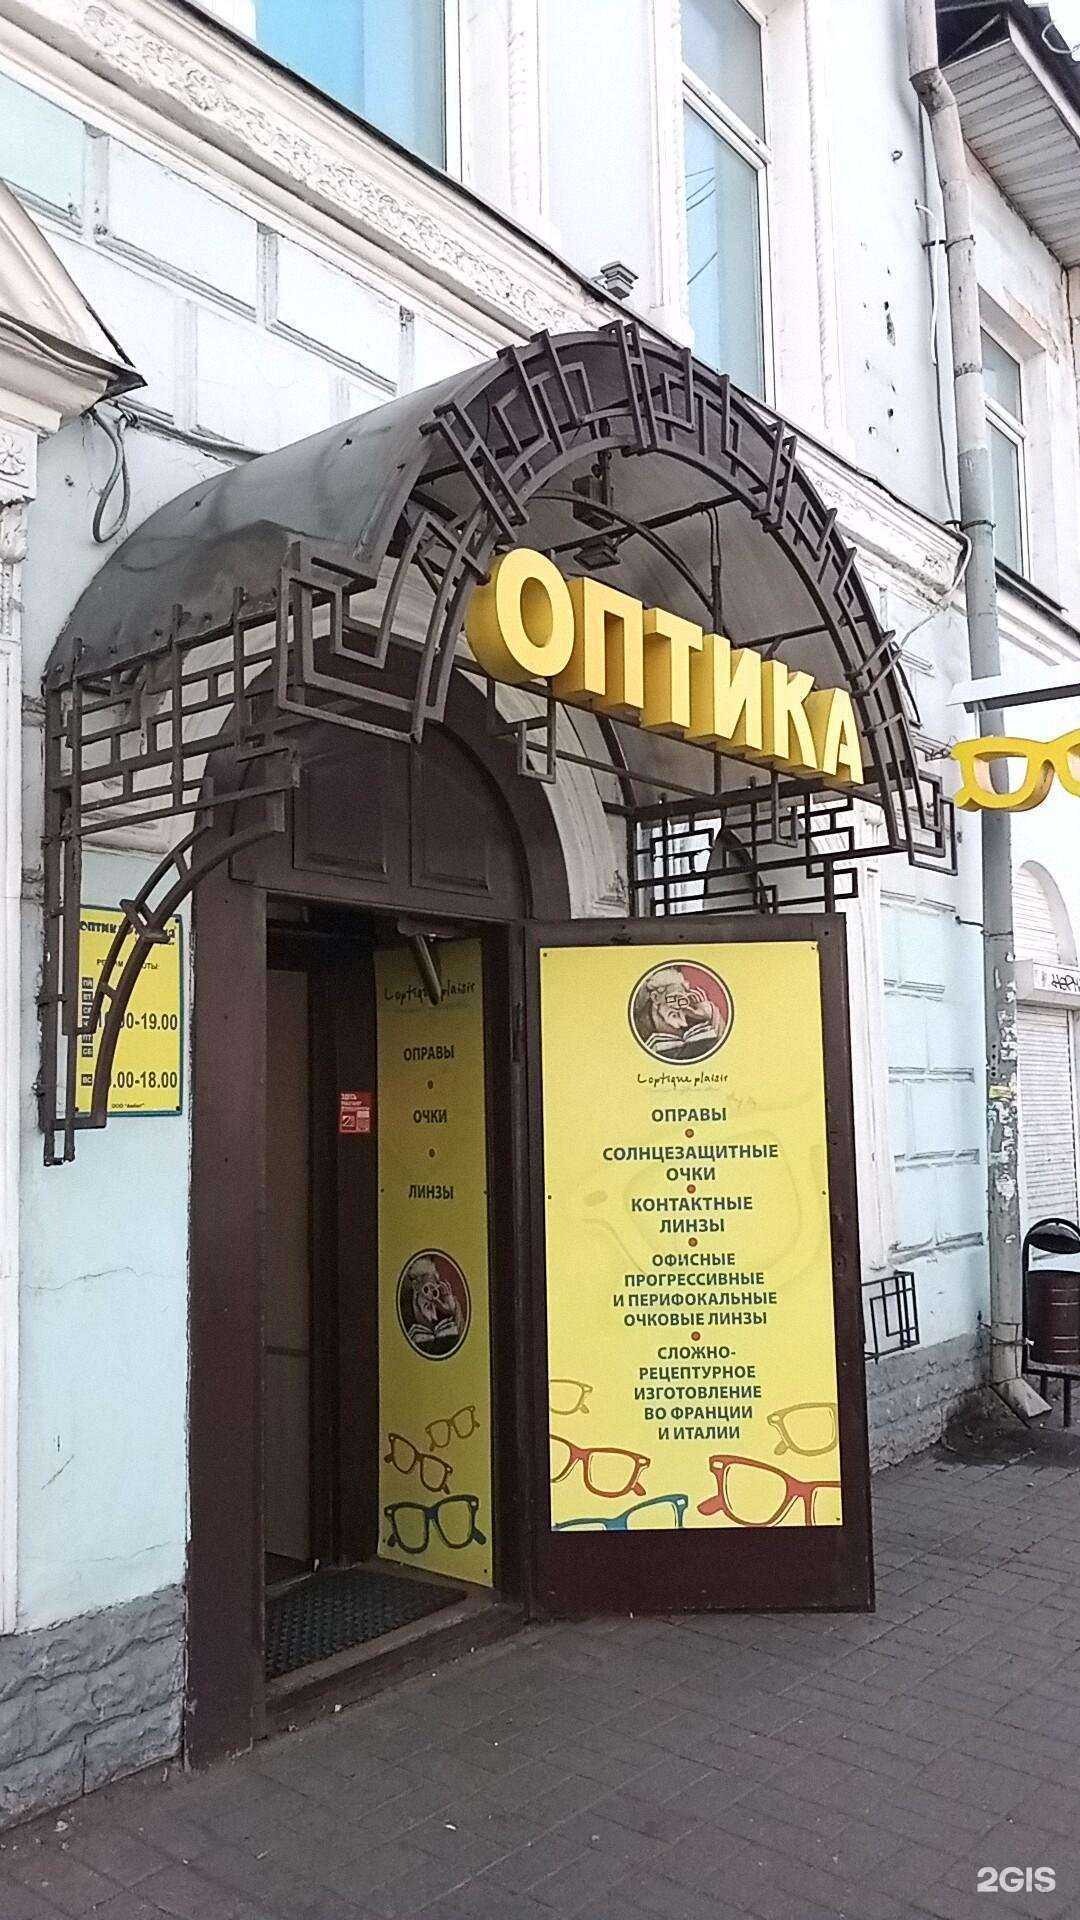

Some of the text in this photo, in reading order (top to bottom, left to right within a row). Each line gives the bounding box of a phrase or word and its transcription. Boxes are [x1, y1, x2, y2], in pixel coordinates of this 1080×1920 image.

[468, 547, 865, 785] ОПТИКА
[403, 1045, 455, 1061] ОПРАВЫ
[413, 1109, 448, 1125] ОЧКИ
[651, 1108, 727, 1123] ОПРАВЫ
[602, 1144, 779, 1163] СОЛНЦЕЗАЩИТНЫЕ
[666, 1167, 716, 1181] ОЧКИ
[408, 1185, 454, 1200] ЛИНЗЫ
[631, 1196, 753, 1212] КОНТАКТНЫЕ
[659, 1218, 725, 1233] ЛИНЗЫ
[652, 1253, 736, 1267] ОФИСНЫЕ
[624, 1272, 765, 1287] ПРОГРЕССИВНЫЕ
[613, 1291, 777, 1307] И ПЕРИФОКАЛЬНЫЕ
[623, 1311, 767, 1327] ОЧКОВЫЕ ЛИНЗЫ
[657, 1346, 736, 1360] СЛОЖНО-
[639, 1365, 756, 1382] РЕЦЕПТУРНОЕ
[634, 1385, 762, 1400] ИЗГОТОВЛЕНИЕ
[644, 1405, 753, 1421] ВО ФРАНЦИИ
[658, 1426, 740, 1440] И ИТАЛИИ
